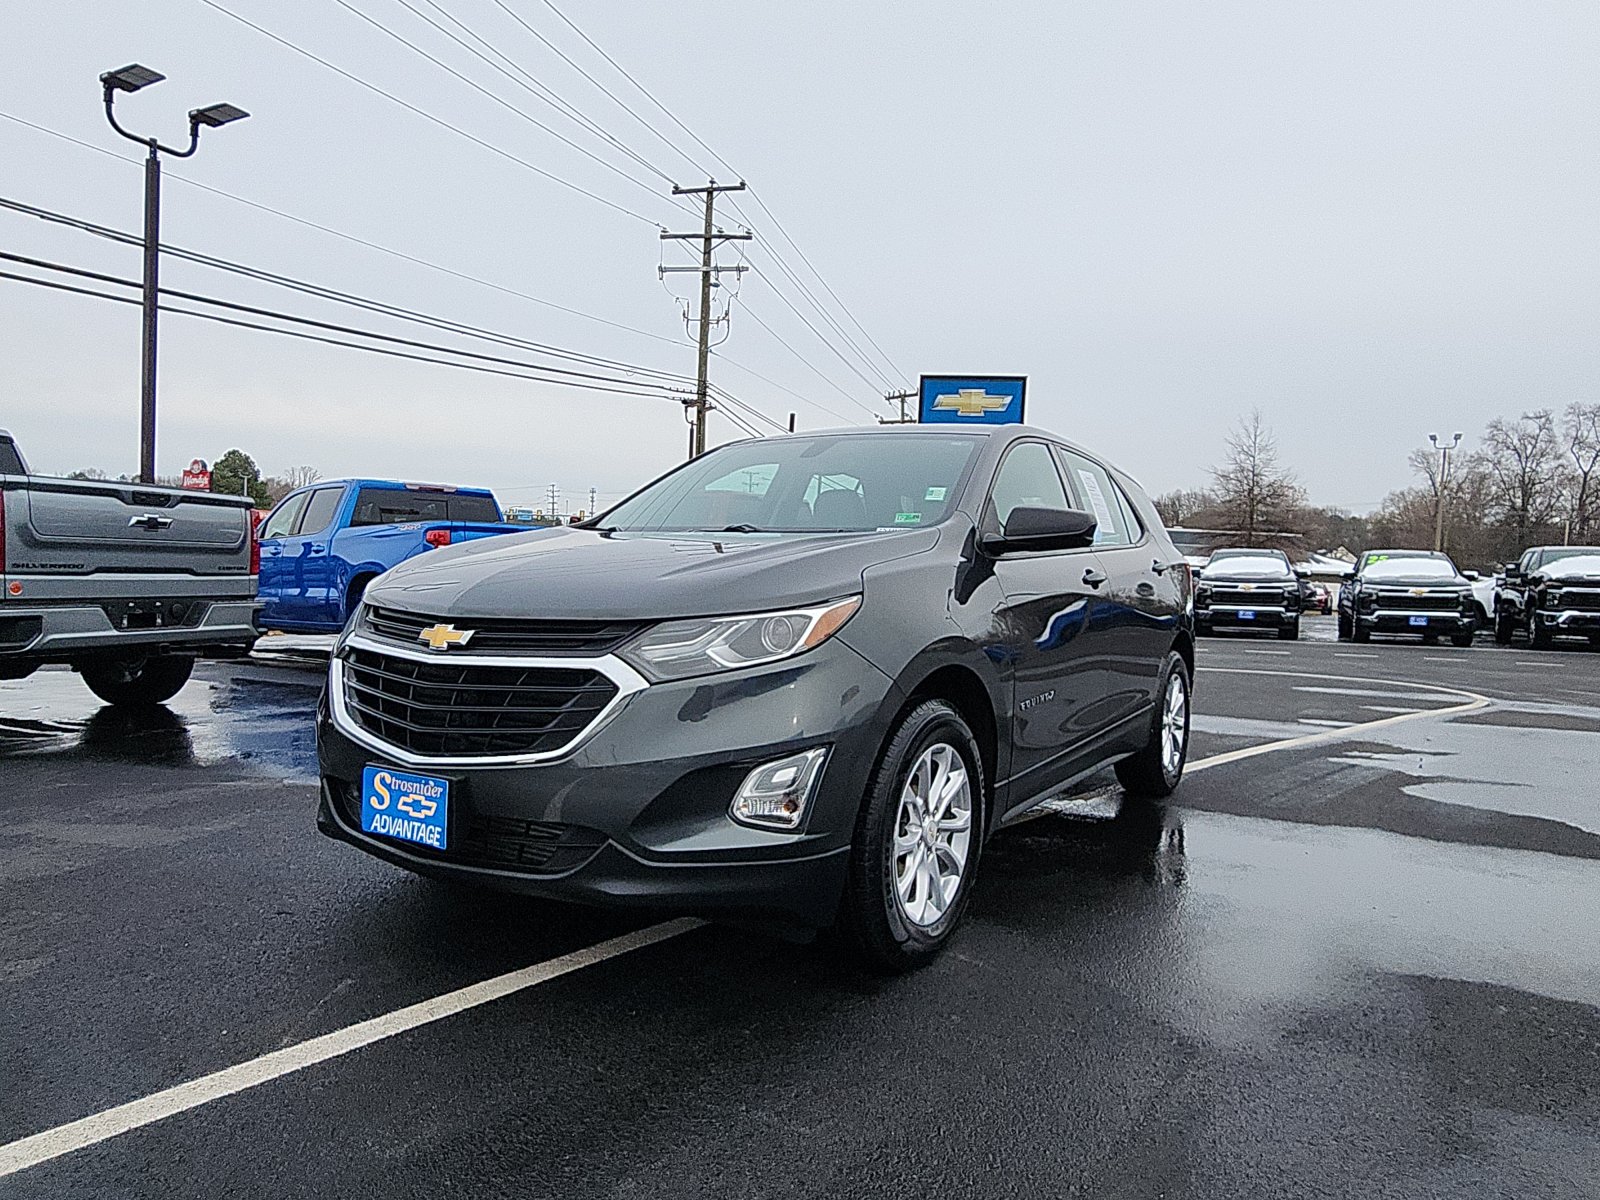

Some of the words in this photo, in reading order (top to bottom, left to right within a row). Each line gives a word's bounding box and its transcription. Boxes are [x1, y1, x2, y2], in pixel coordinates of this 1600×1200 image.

[1020, 690, 1056, 711] EQUINOX
[369, 771, 443, 810] Strosnider
[370, 813, 443, 847] ADVANTAGE
